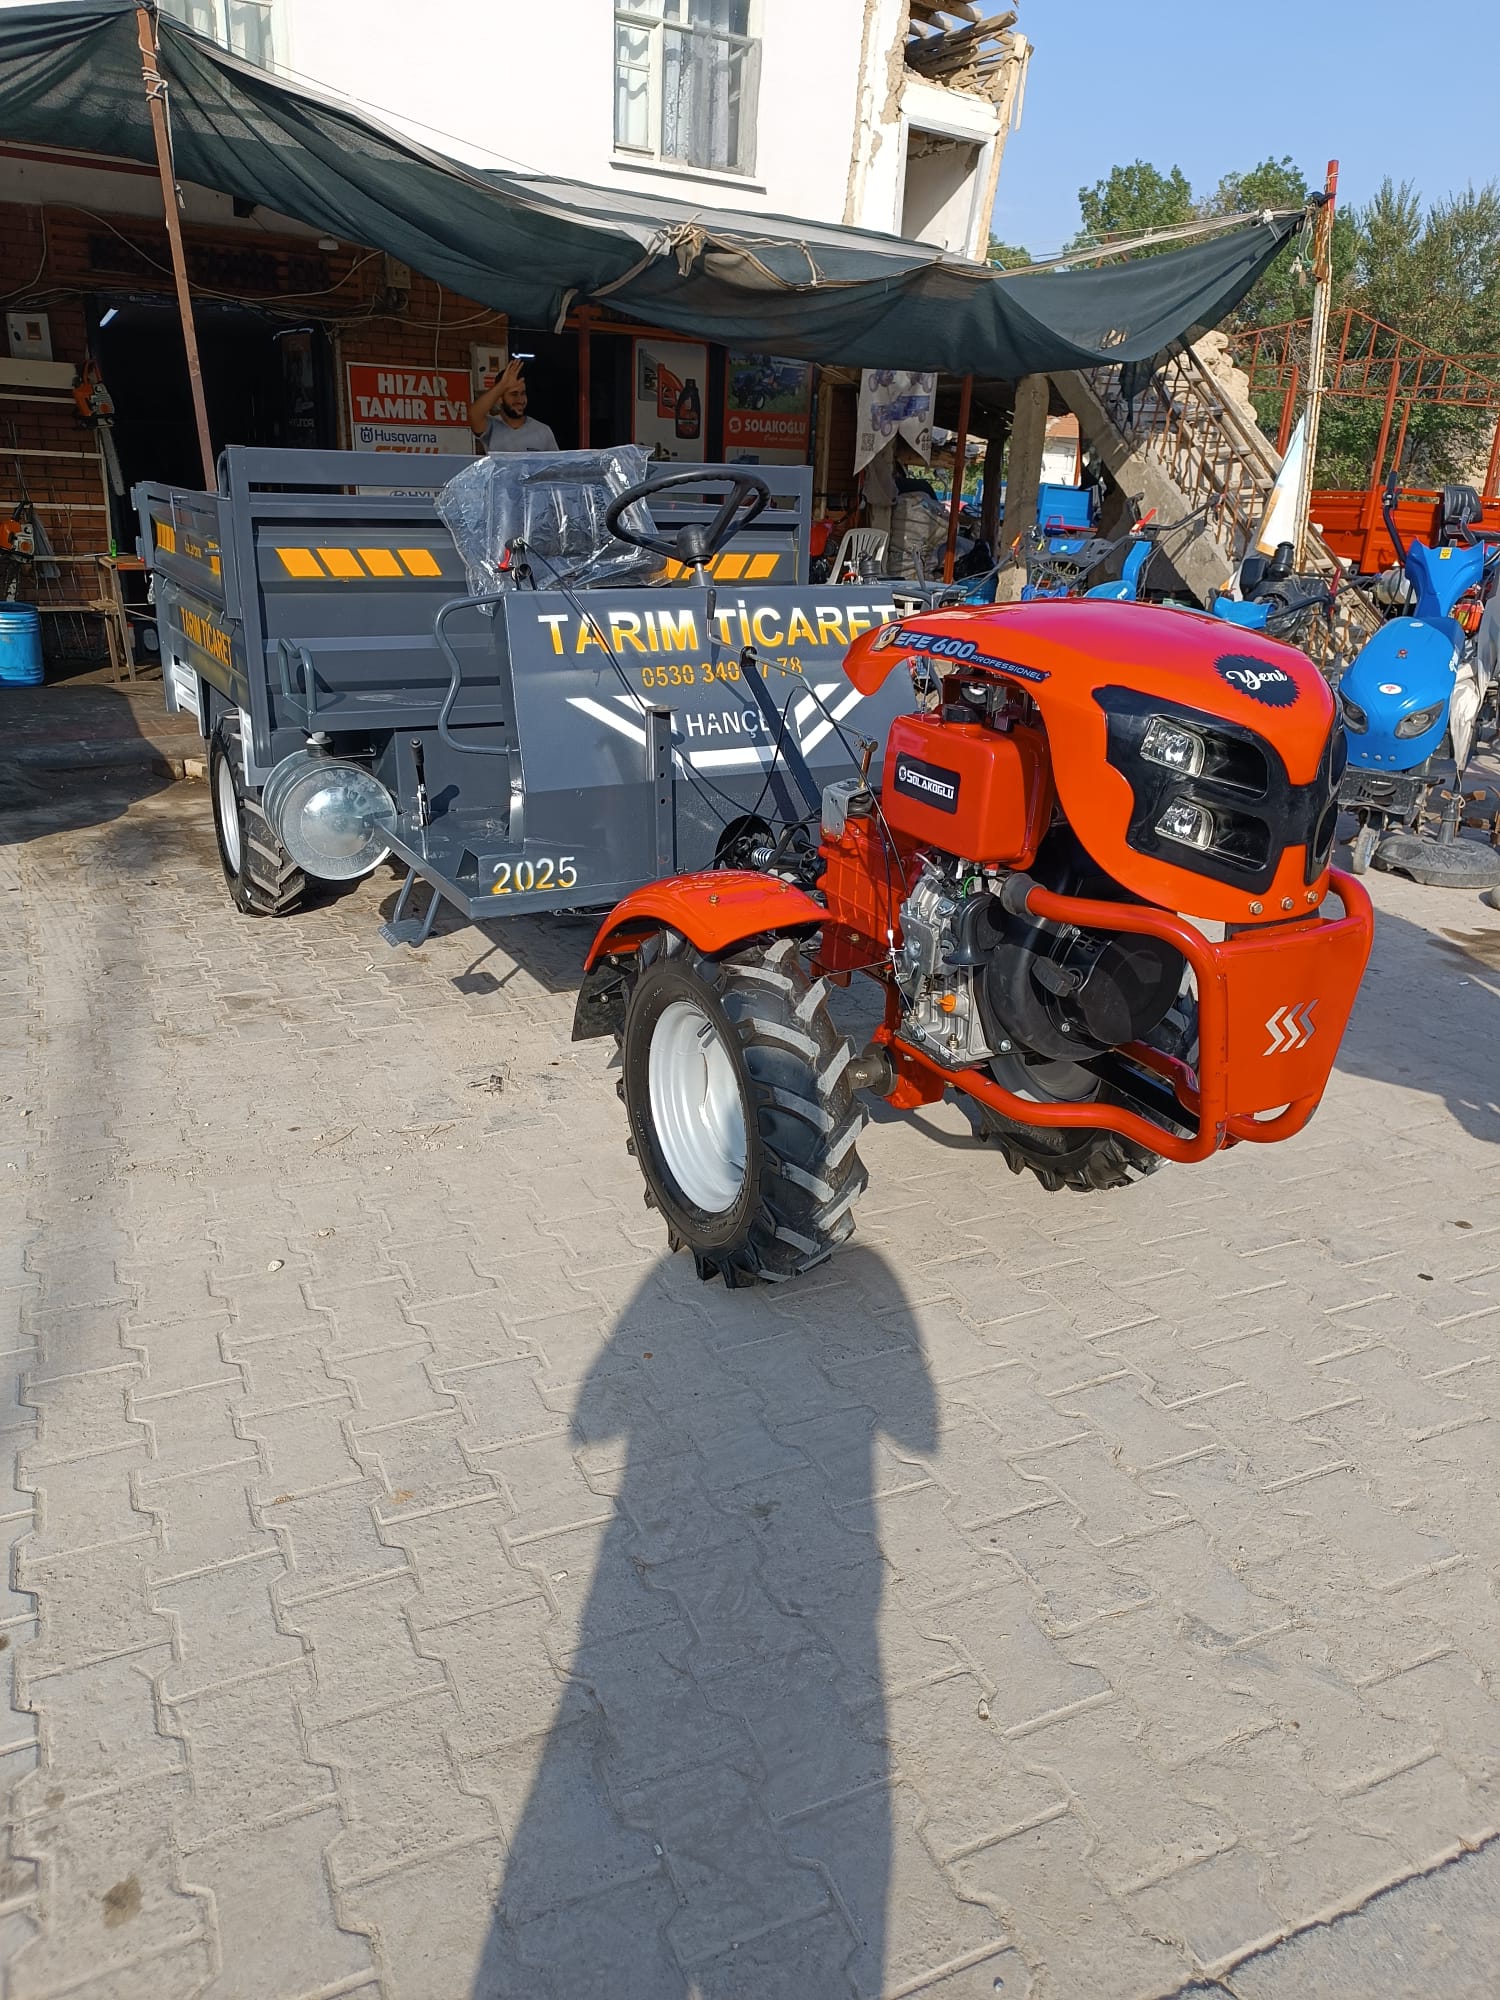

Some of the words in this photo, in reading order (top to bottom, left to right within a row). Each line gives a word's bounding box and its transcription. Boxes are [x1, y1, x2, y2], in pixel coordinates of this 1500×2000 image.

[377, 373, 448, 397] HIZAR
[374, 429, 437, 444] Husqvarna
[538, 609, 699, 655] TARIM
[714, 600, 896, 648] TİCARET
[893, 632, 934, 649] EFE
[931, 638, 976, 659] 600
[641, 664, 695, 688] 0530
[701, 661, 741, 684] 340
[491, 856, 578, 895] 2025
